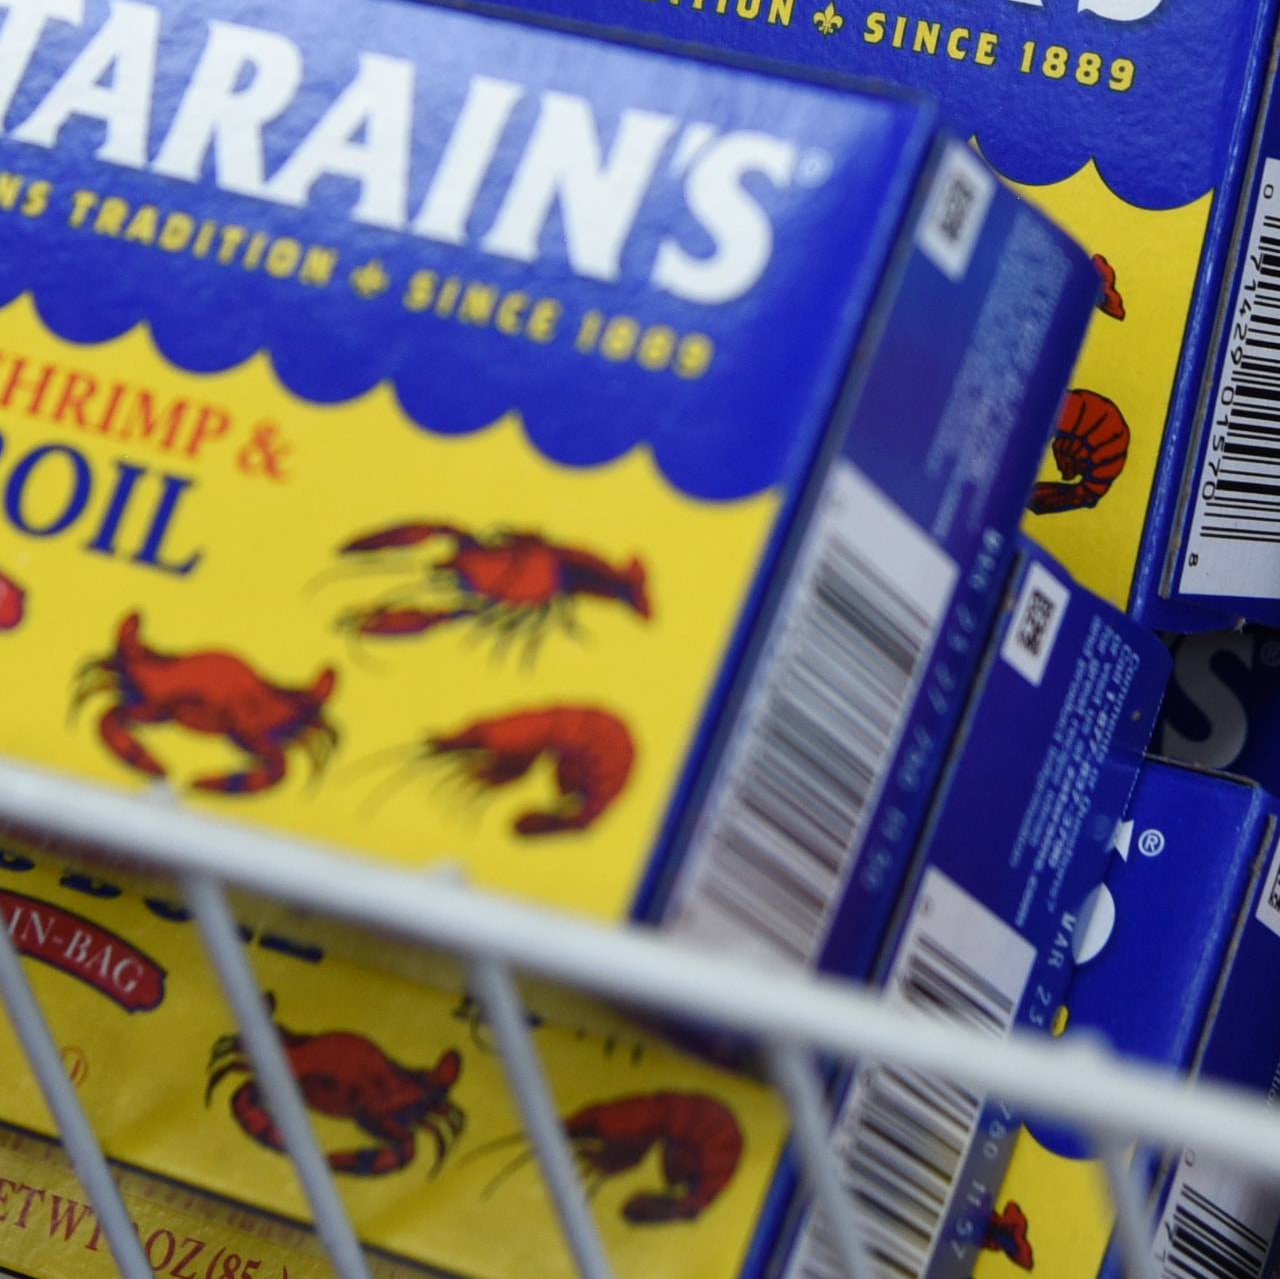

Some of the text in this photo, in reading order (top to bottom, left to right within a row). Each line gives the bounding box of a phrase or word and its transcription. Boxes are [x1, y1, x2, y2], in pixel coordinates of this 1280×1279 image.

[864, 12, 998, 67] SINCE
[1020, 40, 1135, 92] 1889
[67, 189, 338, 287] TRADITION
[403, 269, 563, 343] SINCE
[1229, 253, 1264, 367] 71429
[236, 418, 293, 481] &
[1201, 385, 1235, 501] 01570
[144, 1228, 207, 1279] OZ
